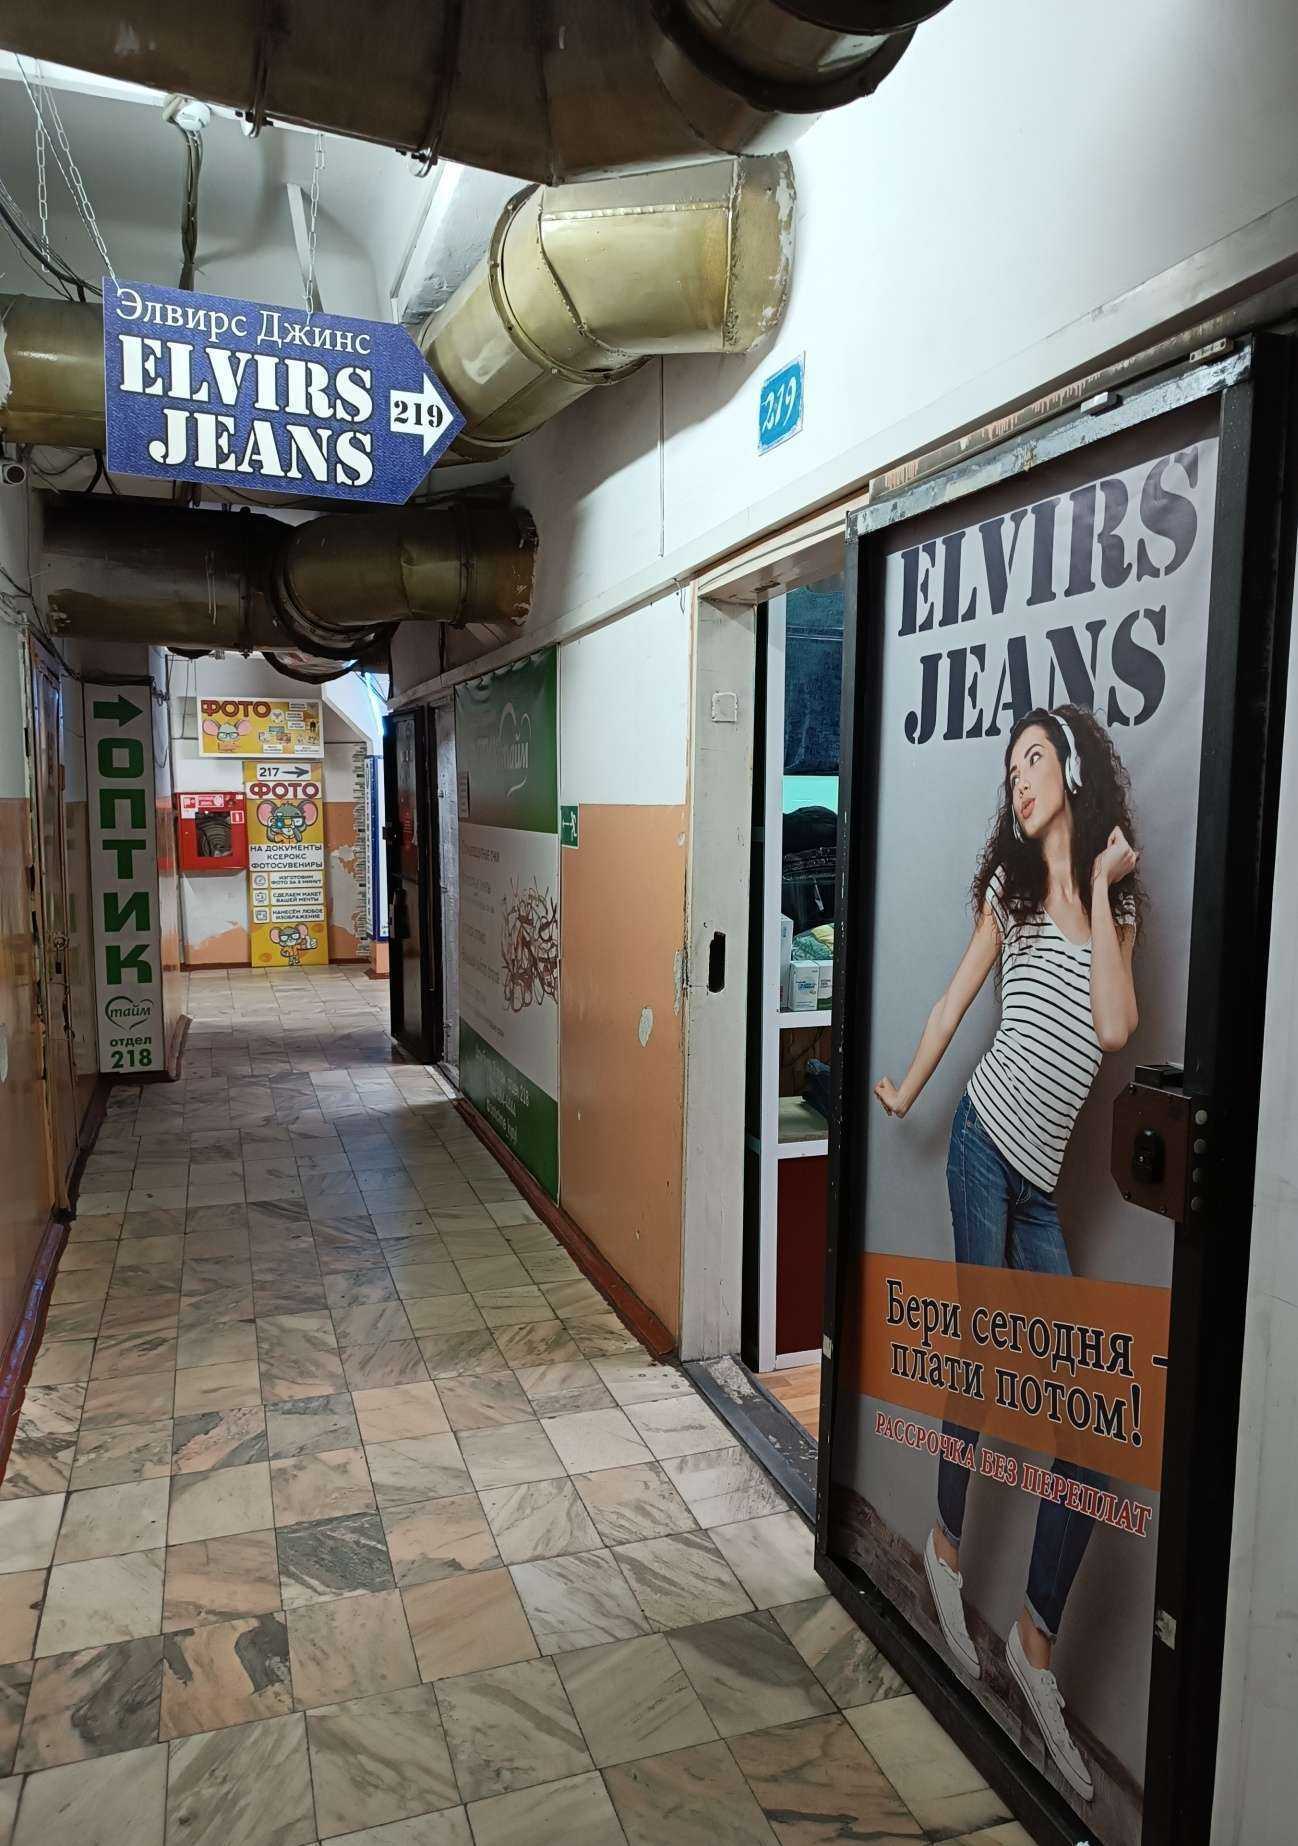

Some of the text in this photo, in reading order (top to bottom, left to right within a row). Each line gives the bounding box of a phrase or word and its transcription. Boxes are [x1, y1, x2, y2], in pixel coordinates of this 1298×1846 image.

[116, 288, 371, 355] Элвирс Джинс
[117, 334, 373, 423] ELVIRS
[393, 400, 443, 428] 219
[761, 376, 797, 433] 219
[149, 408, 373, 486] JEANS
[898, 446, 1199, 637] ELVIRS
[904, 604, 1167, 745] JEANS
[201, 699, 271, 718] ФОТО
[249, 782, 320, 799] ФОТО
[259, 767, 280, 777] 217
[251, 861, 323, 869] ФОТОСУВЕНИРЫ
[265, 844, 322, 852] ДОКУМЕНТЫ
[110, 1002, 151, 1018] тайм
[110, 1036, 152, 1048] отдел
[111, 1048, 153, 1069] 218
[886, 1278, 961, 1348] Бери
[972, 1306, 1134, 1377] сегодня
[890, 1342, 1144, 1447] плати потом!
[874, 1412, 1152, 1537] РАССРОЧКА БЕЗ ПЕРЕПЛАТ
